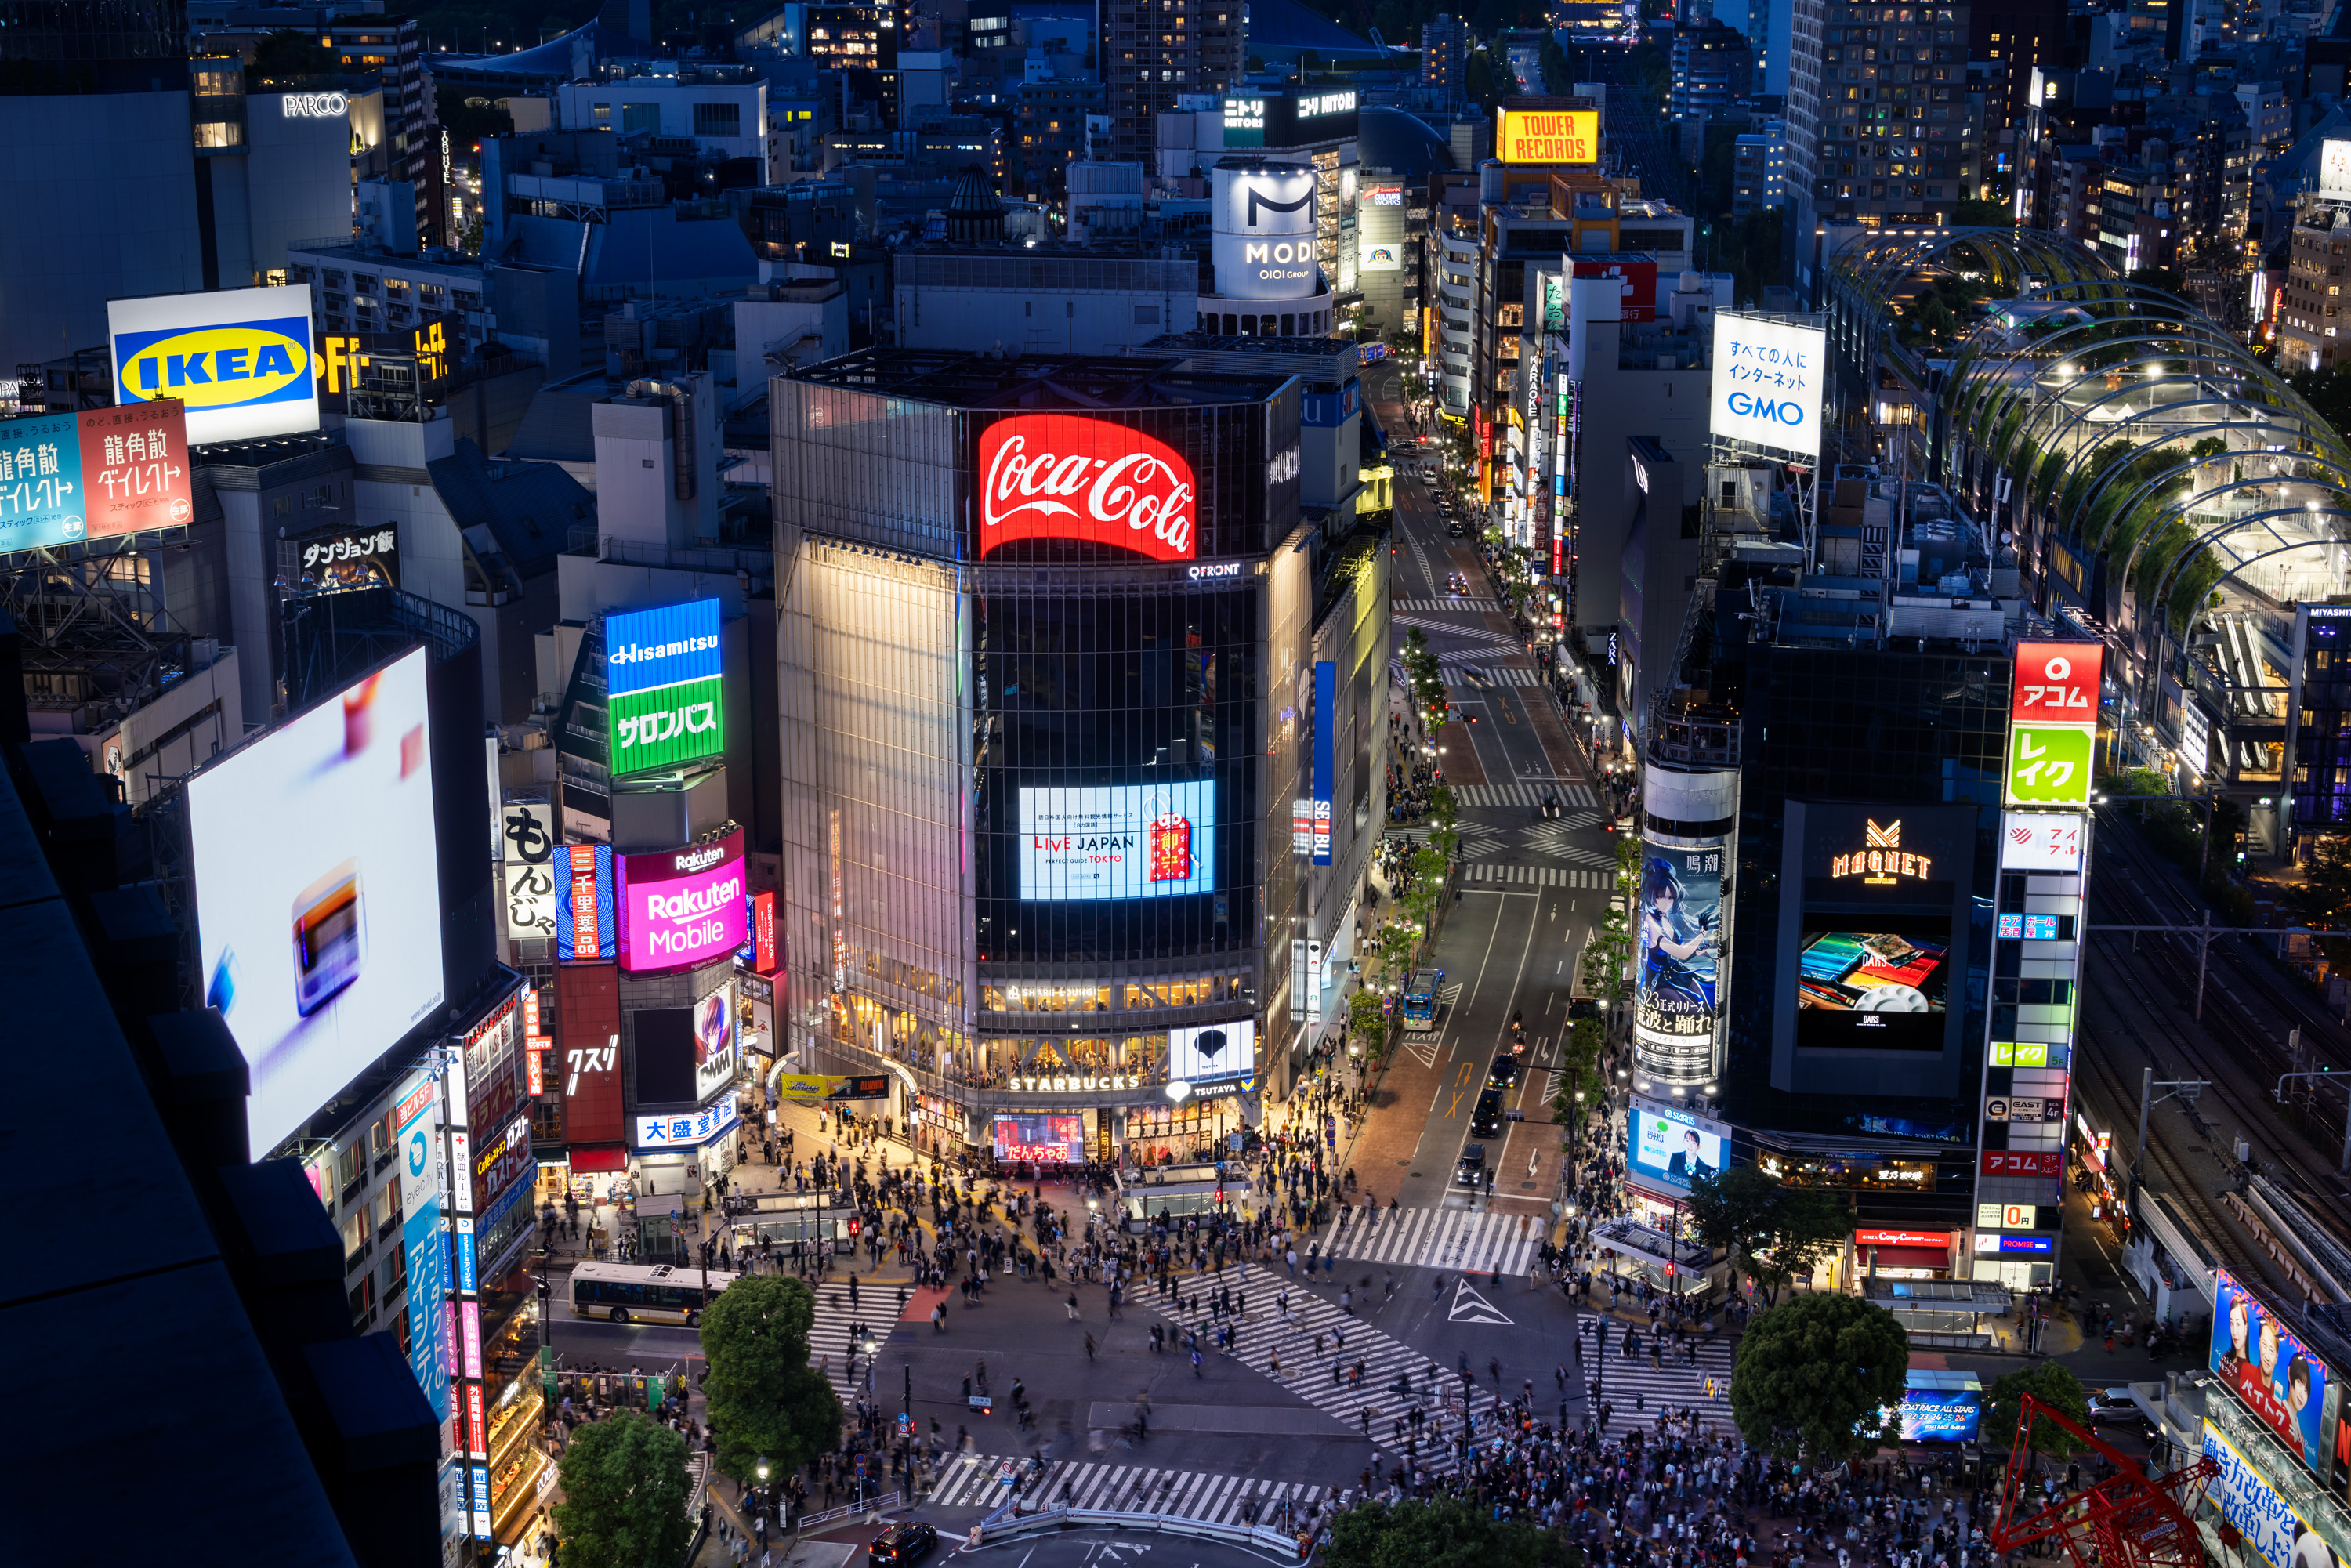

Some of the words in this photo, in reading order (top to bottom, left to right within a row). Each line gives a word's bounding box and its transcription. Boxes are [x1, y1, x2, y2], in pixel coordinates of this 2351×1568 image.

[284, 94, 346, 116] PARCO
[1224, 100, 1264, 117] ニトリ
[1299, 97, 1319, 118] ニトリ
[1321, 92, 1355, 114] NITORI
[1224, 118, 1264, 128] NITORI
[1522, 116, 1575, 136] TOWER
[1516, 139, 1586, 159] RECORDS
[1246, 240, 1316, 263] MODI
[139, 343, 297, 390] IKEA
[1730, 341, 1807, 368] すべての人に
[1528, 355, 1539, 417] KARAOKE
[1729, 364, 1806, 391] インターネット
[1728, 392, 1804, 425] GMO
[103, 429, 168, 466] 龍角散
[97, 462, 181, 499] ダイレクト
[985, 435, 1194, 553] Coca-Cola
[110, 500, 143, 512] スティック
[1536, 502, 1546, 548] 東日本銀行
[303, 531, 394, 568] ダンジョン飯
[1189, 563, 1241, 580] QFRONT
[610, 635, 719, 664] Hisamitsu
[1607, 632, 1617, 665] ZARA
[2023, 686, 2088, 707] アコム
[618, 701, 716, 748] サロンパス
[1314, 800, 1330, 856] SEIBU
[1035, 836, 1071, 853] LIVE
[1077, 835, 1134, 851] JAPAN
[1160, 832, 1179, 871] 御守
[505, 807, 556, 936] もんじゃ
[676, 847, 724, 871] Rakuten
[1686, 853, 1719, 874] 鳴潮
[1831, 850, 1931, 879] MAGNET
[572, 853, 596, 954] 三千里薬品
[648, 878, 740, 923] Rakuten
[650, 919, 724, 955] Mobile
[2045, 930, 2055, 939] 7F
[1862, 954, 1888, 967] DAKS
[1022, 987, 1055, 997] SHARE
[1636, 1005, 1712, 1034] 荒波と踊れ
[1863, 1015, 1880, 1023] DAKS
[700, 1046, 730, 1088] DMM
[1999, 1046, 2044, 1060] レイク
[2052, 1056, 2064, 1066] 5F
[860, 1079, 885, 1091] ALVARK
[1009, 1076, 1139, 1091] STARBUCKS
[1194, 1085, 1237, 1096] TSUTAYA
[400, 1083, 430, 1124] 当ビル5F
[2046, 1107, 2059, 1117] 4F
[506, 1114, 529, 1151] ガスト
[647, 1098, 732, 1140] 大盛堂書店
[1008, 1144, 1069, 1160] だんちゃお
[1101, 1137, 1109, 1146] OF
[1762, 1167, 1783, 1179] COFFEE
[1990, 1156, 2038, 1170] アコム
[2045, 1155, 2057, 1164] 3F
[406, 1171, 434, 1206] eyecity
[456, 1153, 468, 1201] 献血ルーム
[1878, 1232, 1900, 1244] Cozy
[1899, 1233, 1925, 1242] Corner
[427, 1227, 446, 1389] コンタクトの
[469, 1367, 480, 1376] 4F
[470, 1385, 481, 1422] 外貨両替
[2241, 1378, 2286, 1427] ペイトク
[2143, 1523, 2175, 1541] UCHIMIYA
